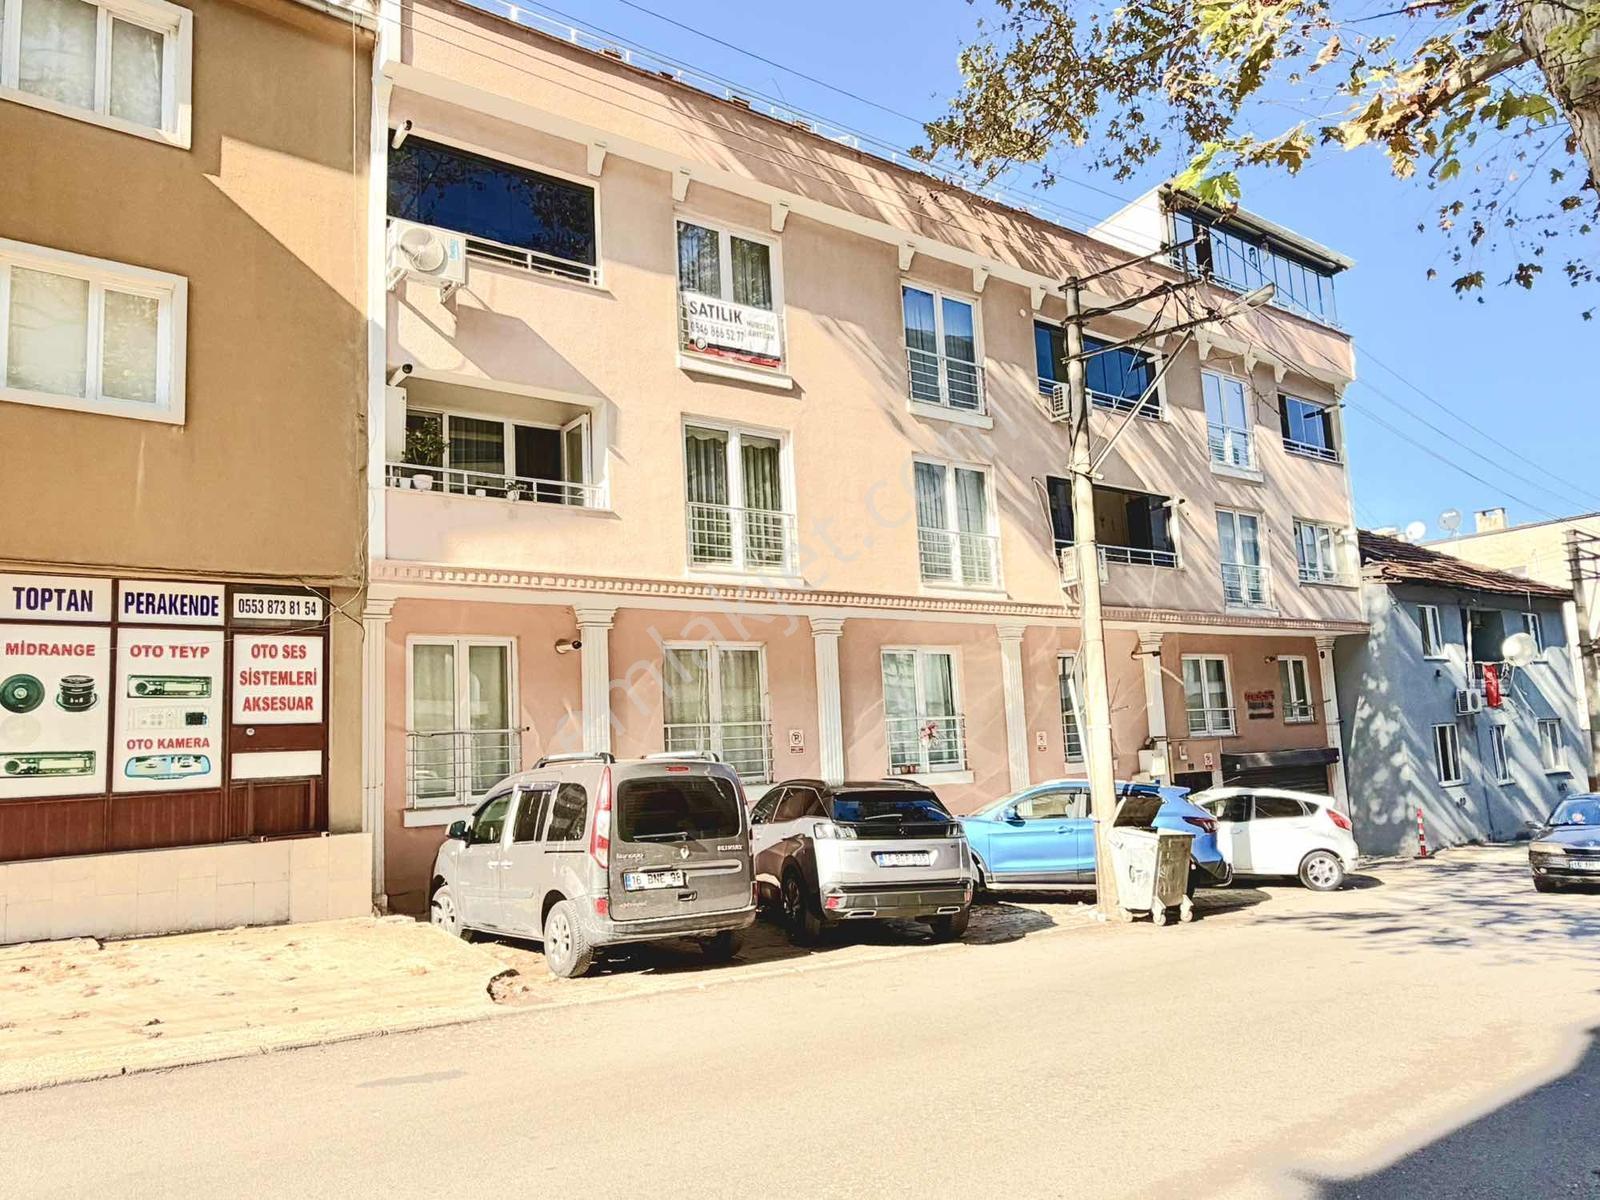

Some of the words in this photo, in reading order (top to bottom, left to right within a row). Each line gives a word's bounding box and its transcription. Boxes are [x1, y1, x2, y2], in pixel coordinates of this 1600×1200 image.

[689, 300, 743, 325] SATILIK
[12, 586, 94, 612] TOPTAN
[124, 591, 219, 617] PERAKENDE
[238, 598, 264, 614] 0553
[267, 599, 286, 615] 873
[289, 600, 301, 615] 81
[304, 601, 317, 616] 54
[5, 640, 96, 657] MİDRANGE
[129, 644, 164, 658] OTO
[168, 645, 210, 658] TEYP
[251, 643, 278, 659] OTO
[282, 644, 307, 659] SES
[239, 667, 317, 686] SİSTEMLERİ
[242, 696, 314, 712] AKSESUAR
[126, 738, 154, 750] OTO
[157, 737, 210, 750] KAMERA
